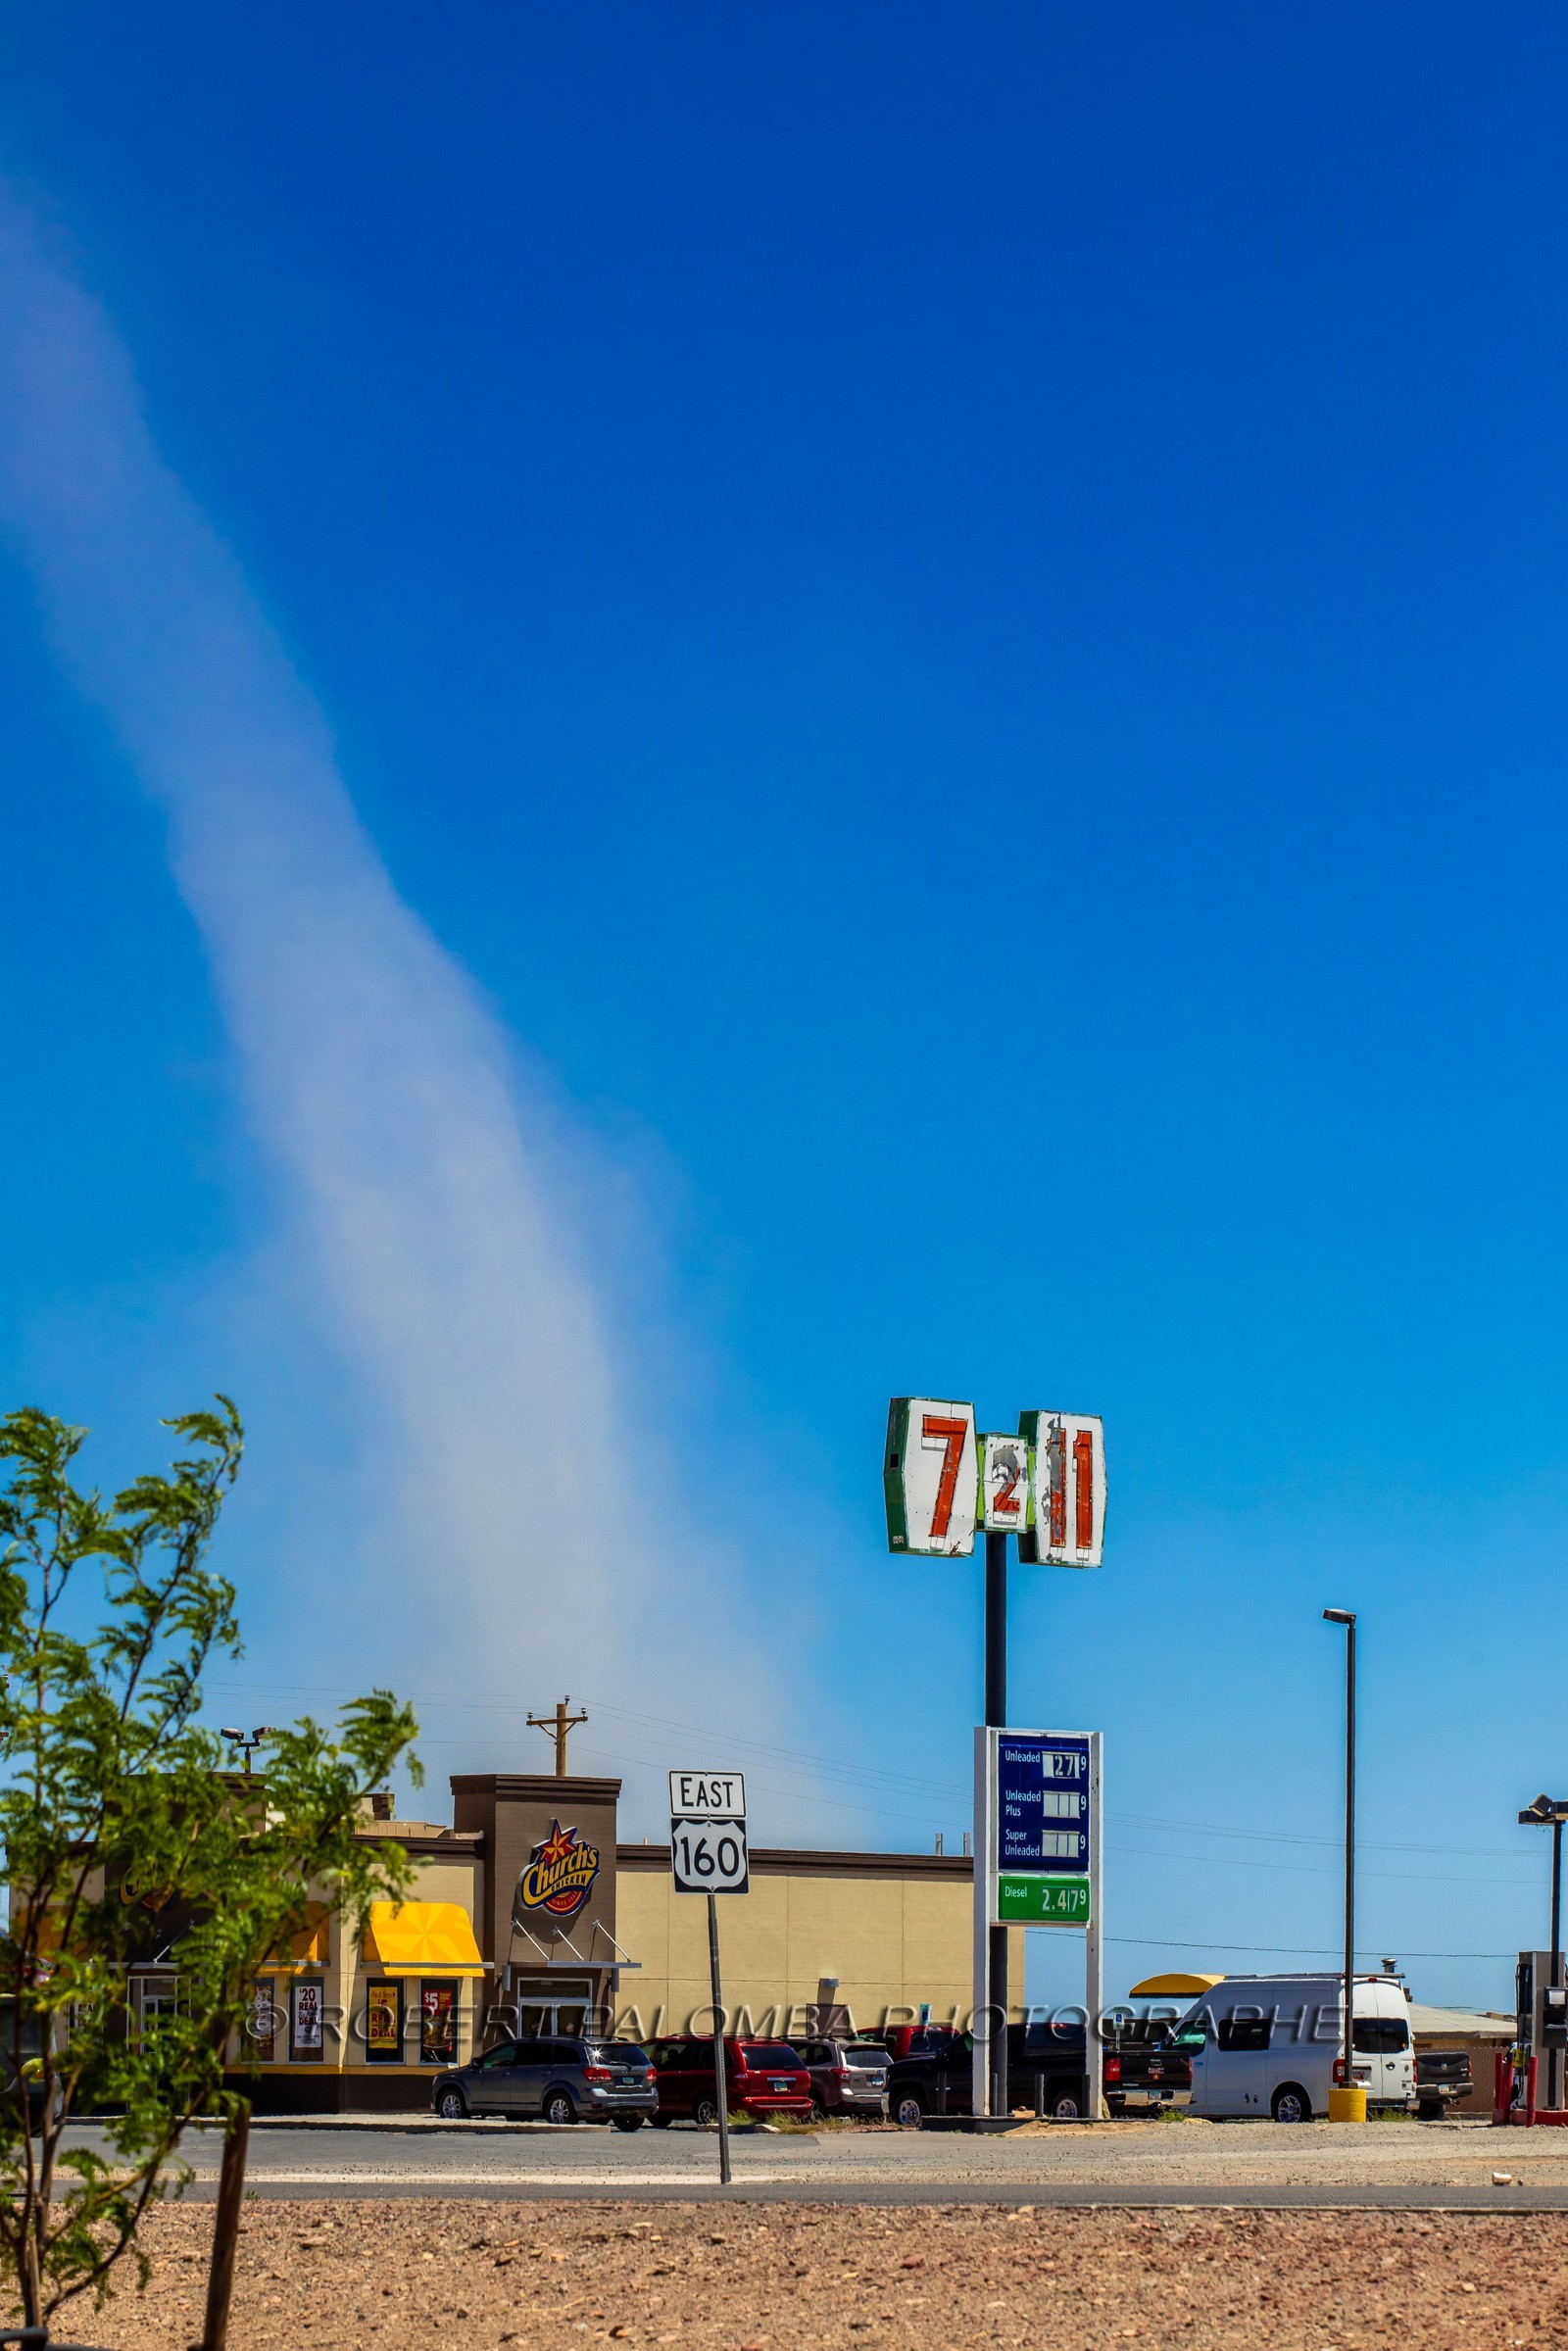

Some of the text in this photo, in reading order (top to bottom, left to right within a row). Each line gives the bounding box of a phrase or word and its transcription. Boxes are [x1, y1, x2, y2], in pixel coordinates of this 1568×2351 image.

[922, 1414, 968, 1538] 7
[1047, 1428, 1093, 1549] 11
[1004, 1749, 1041, 1763] Unleaded
[680, 1777, 734, 1808] EAST
[1005, 1789, 1087, 1811] Unleaded 9
[1005, 1805, 1021, 1817] Plus
[1005, 1829, 1086, 1850] Super 9
[680, 1837, 740, 1877] 160
[1004, 1844, 1041, 1857] Unleaded
[522, 1842, 598, 1905] Church's
[551, 1873, 587, 1892] CHICKEN
[1004, 1886, 1028, 1898] Diesel
[298, 2001, 318, 2011] REAL
[424, 1991, 438, 2011] $5
[298, 2017, 318, 2026] DEAL
[371, 2028, 396, 2037] DEAL
